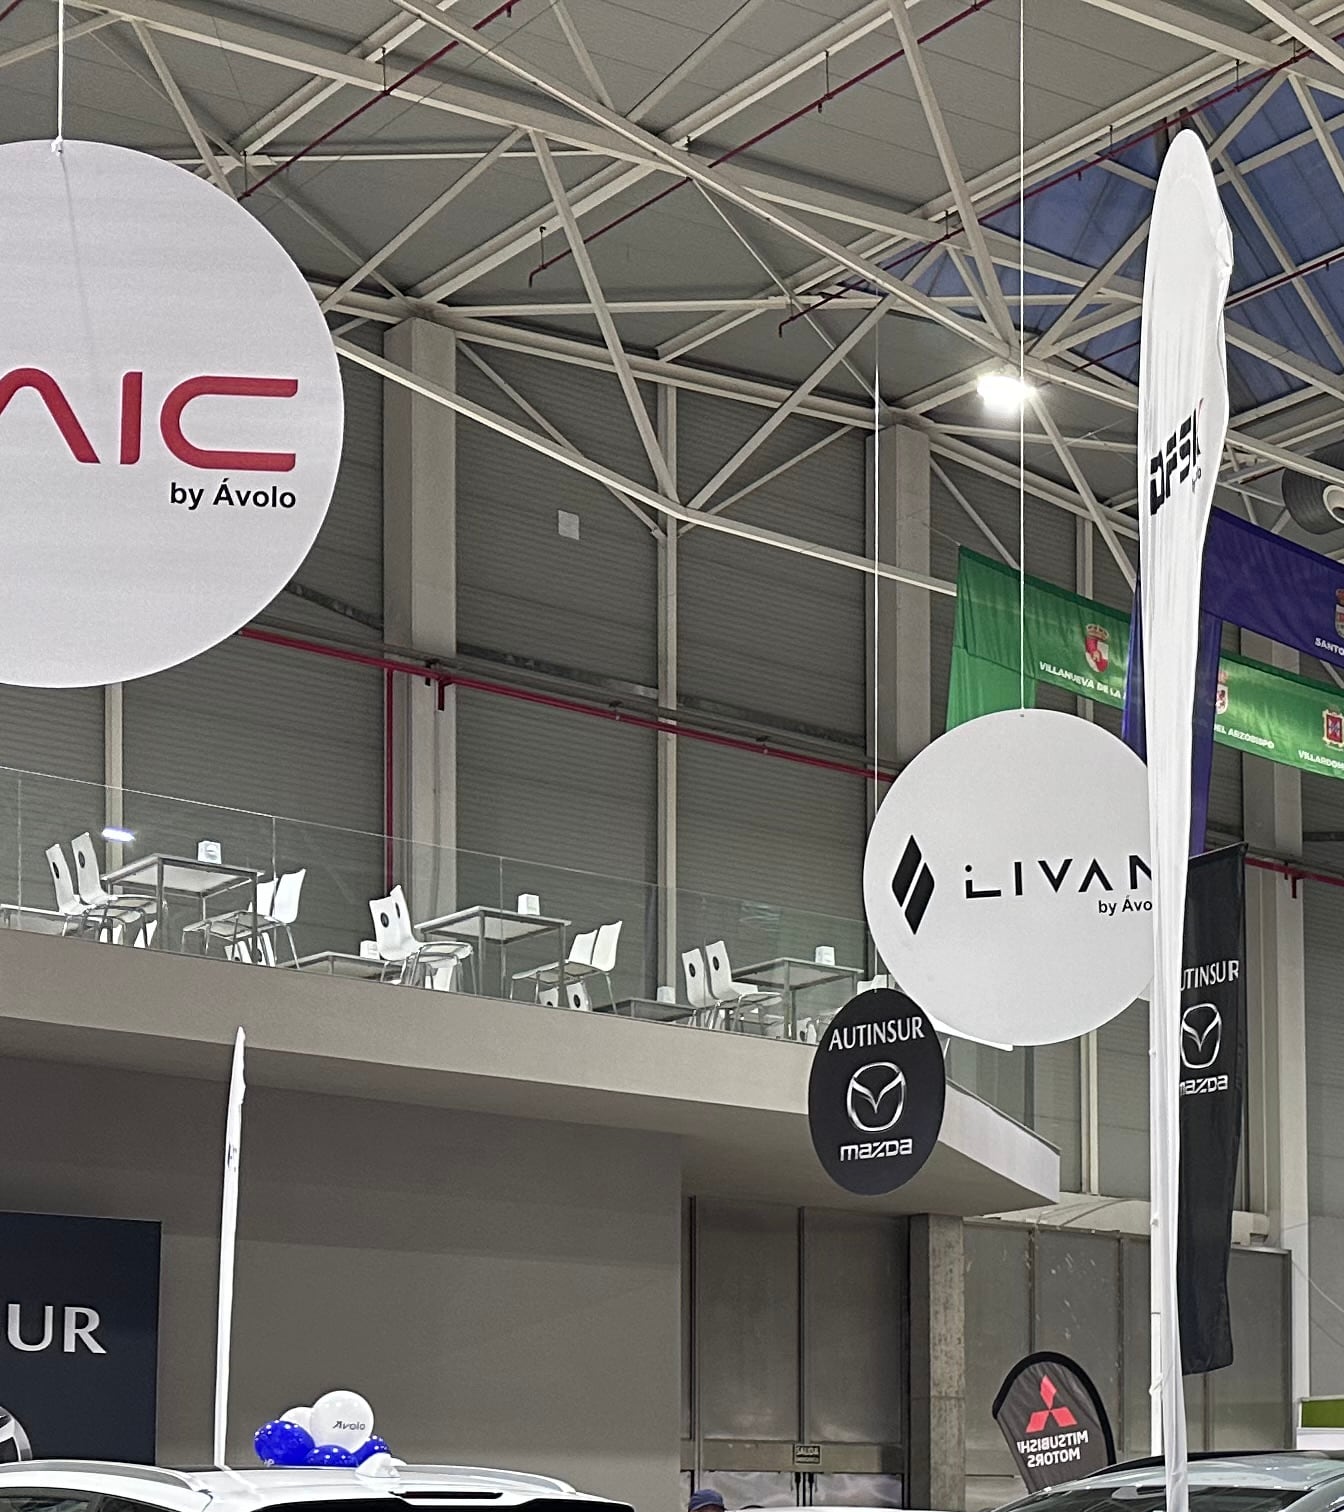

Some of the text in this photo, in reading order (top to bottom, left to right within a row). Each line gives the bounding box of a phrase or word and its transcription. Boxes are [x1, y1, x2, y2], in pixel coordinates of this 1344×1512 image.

[0, 367, 298, 472] AIC
[169, 477, 297, 510] by Ávolo
[964, 854, 1153, 899] LIVAN
[1098, 894, 1153, 916] by Ávo
[1180, 960, 1240, 991] UTINSUR
[828, 1016, 926, 1052] AUTINSUR
[839, 1138, 913, 1162] mazda
[7, 1303, 107, 1354] UR
